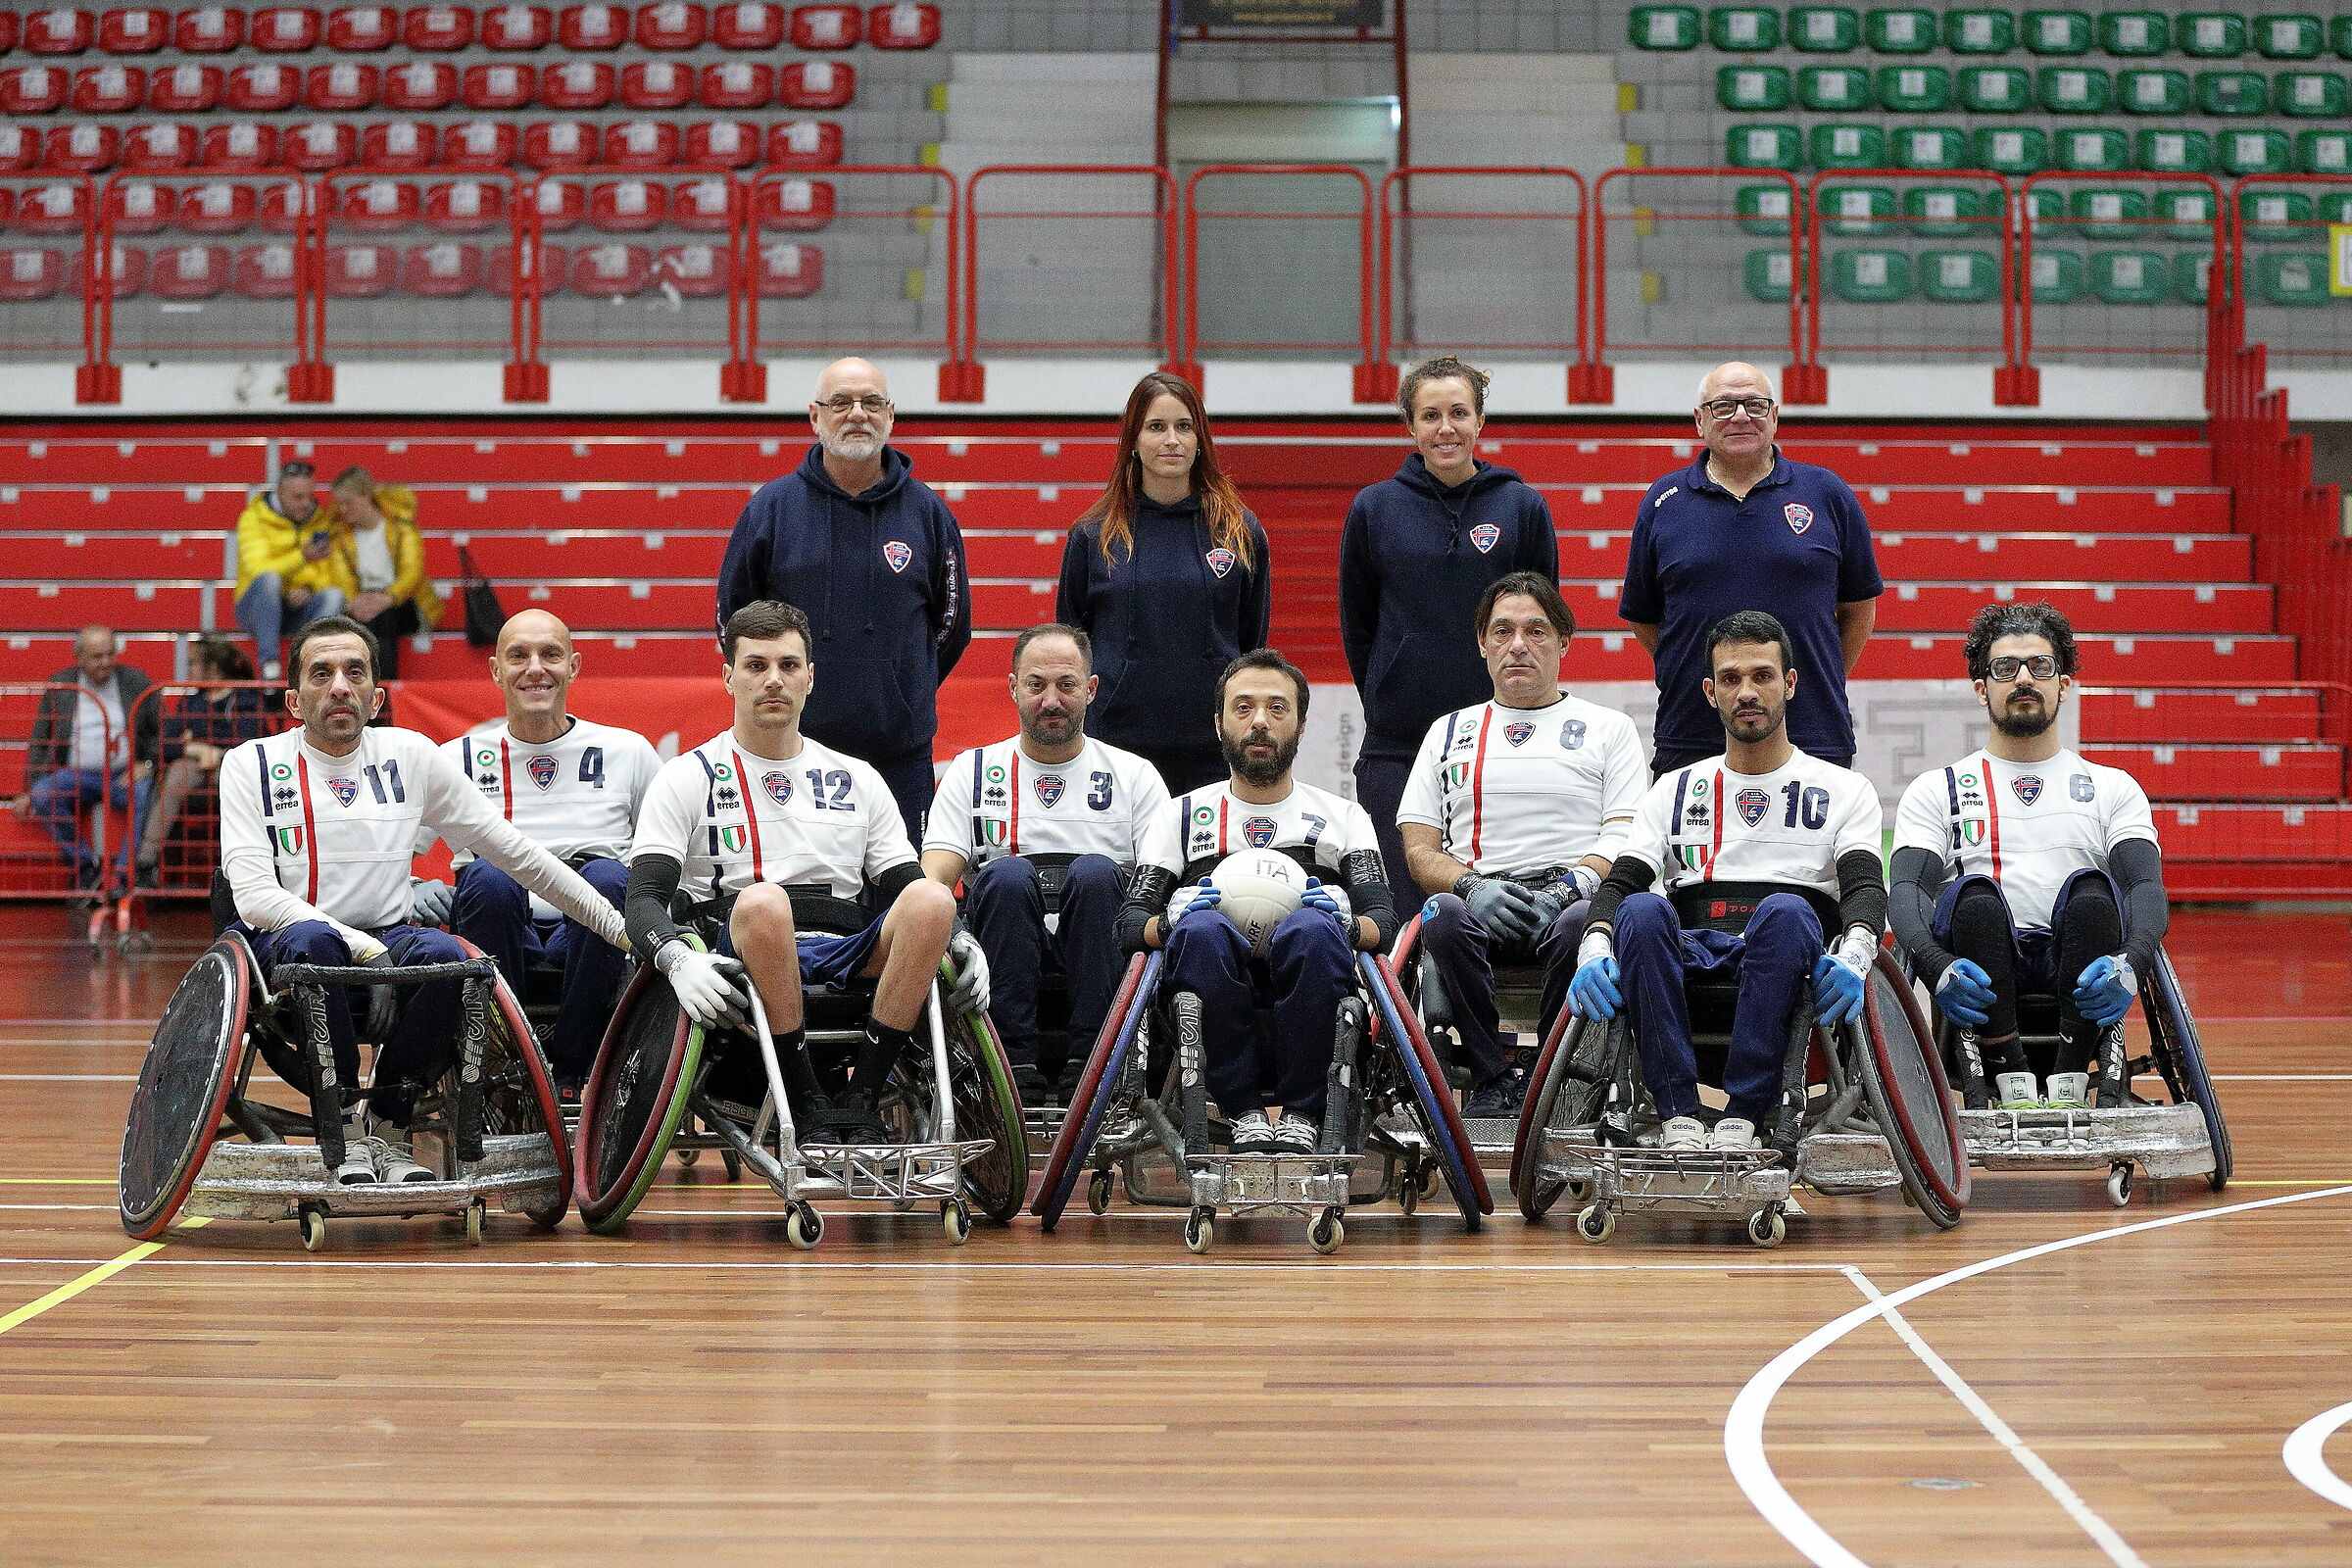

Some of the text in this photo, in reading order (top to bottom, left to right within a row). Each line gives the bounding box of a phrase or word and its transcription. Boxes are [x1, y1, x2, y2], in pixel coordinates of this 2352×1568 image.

[1559, 719, 1587, 751] 8
[363, 759, 406, 804] 11
[578, 746, 606, 789] 4
[806, 768, 856, 811] 12
[1087, 771, 1113, 811] 3
[1781, 780, 1830, 831] 10
[2069, 773, 2095, 803] 6
[1300, 812, 1328, 847] 7
[1256, 858, 1290, 883] ITA
